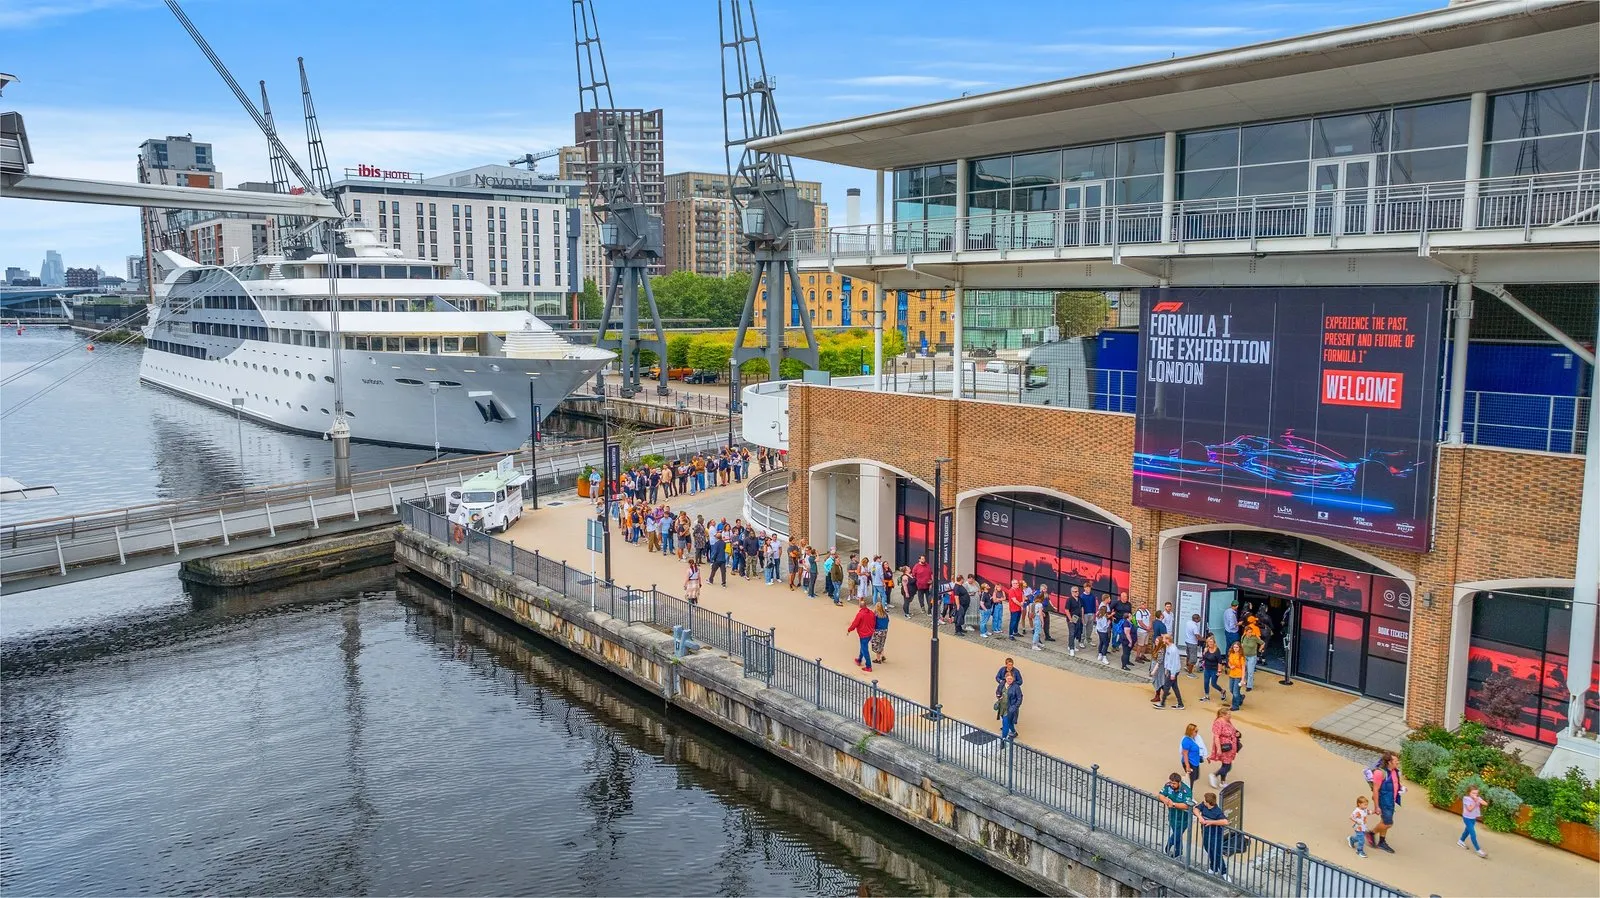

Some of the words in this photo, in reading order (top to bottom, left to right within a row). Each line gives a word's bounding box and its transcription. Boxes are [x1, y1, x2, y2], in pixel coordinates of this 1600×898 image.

[358, 164, 381, 177] ibis
[385, 171, 412, 180] HOTEL
[475, 174, 532, 189] NOVOTEL
[1150, 314, 1216, 337] FORMULA
[1325, 316, 1369, 330] EXPERIENCE
[1372, 317, 1385, 330] THE
[1324, 333, 1355, 346] PRESENT
[1357, 334, 1372, 347] AND
[1374, 334, 1403, 348] FUTURE
[1405, 335, 1415, 348] OF
[1150, 337, 1174, 359] THE
[1177, 338, 1270, 364] EXHIBITION
[1323, 349, 1356, 363] FORMULA
[1148, 360, 1204, 385] LONDON
[1326, 375, 1396, 403] WELCOME
[1378, 626, 1390, 636] BOOK
[1390, 629, 1408, 640] TICKETS
